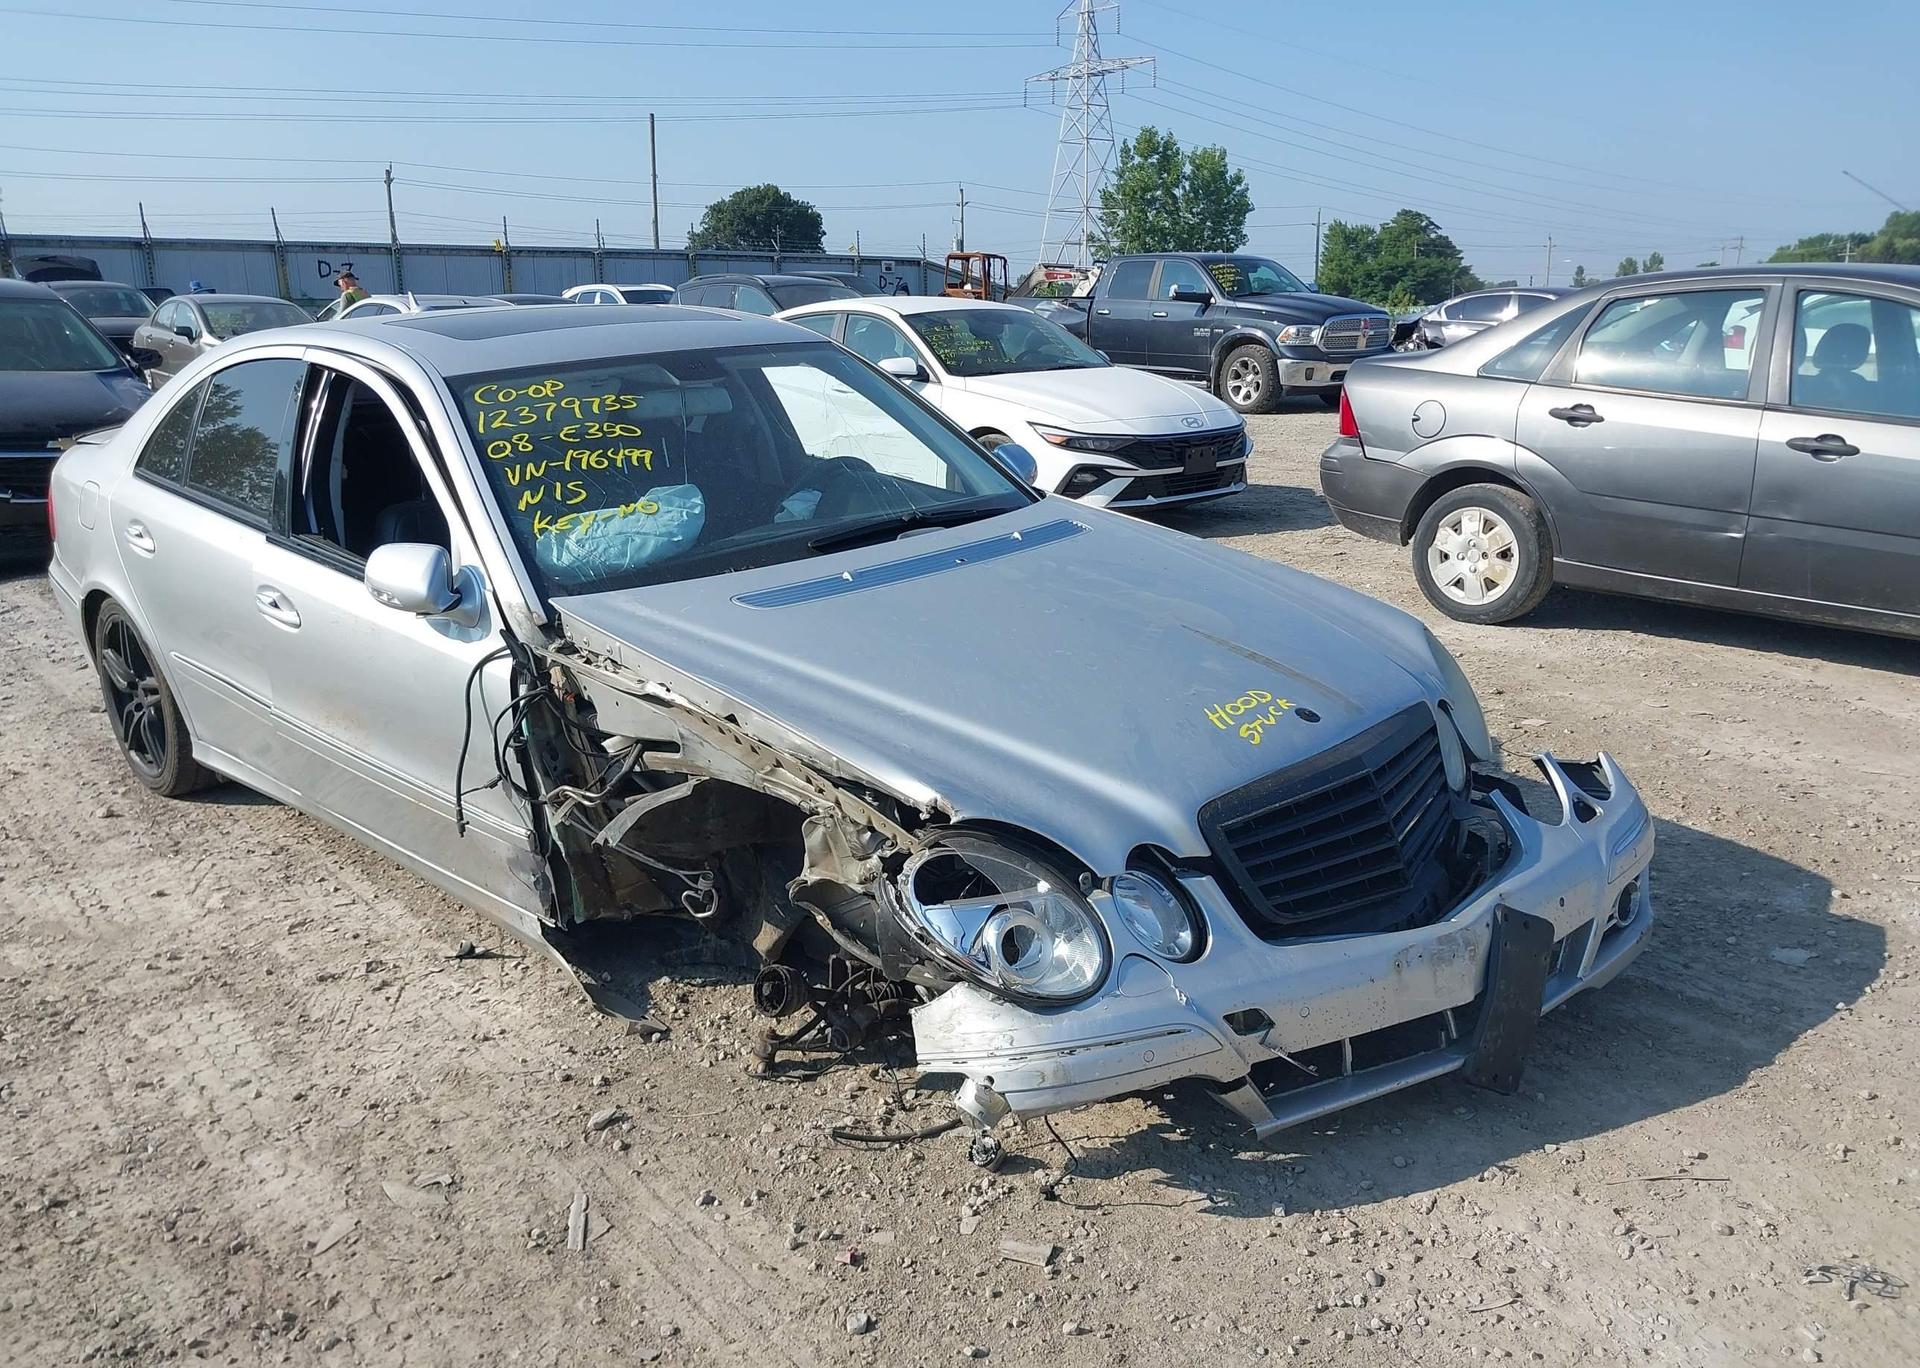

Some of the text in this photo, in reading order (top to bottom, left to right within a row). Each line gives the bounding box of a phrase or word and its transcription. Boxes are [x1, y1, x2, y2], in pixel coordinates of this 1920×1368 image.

[474, 380, 565, 405] CO-OP
[477, 394, 644, 434] 12379735
[1204, 690, 1272, 729] HOOD
[1239, 699, 1297, 744] STUCK
